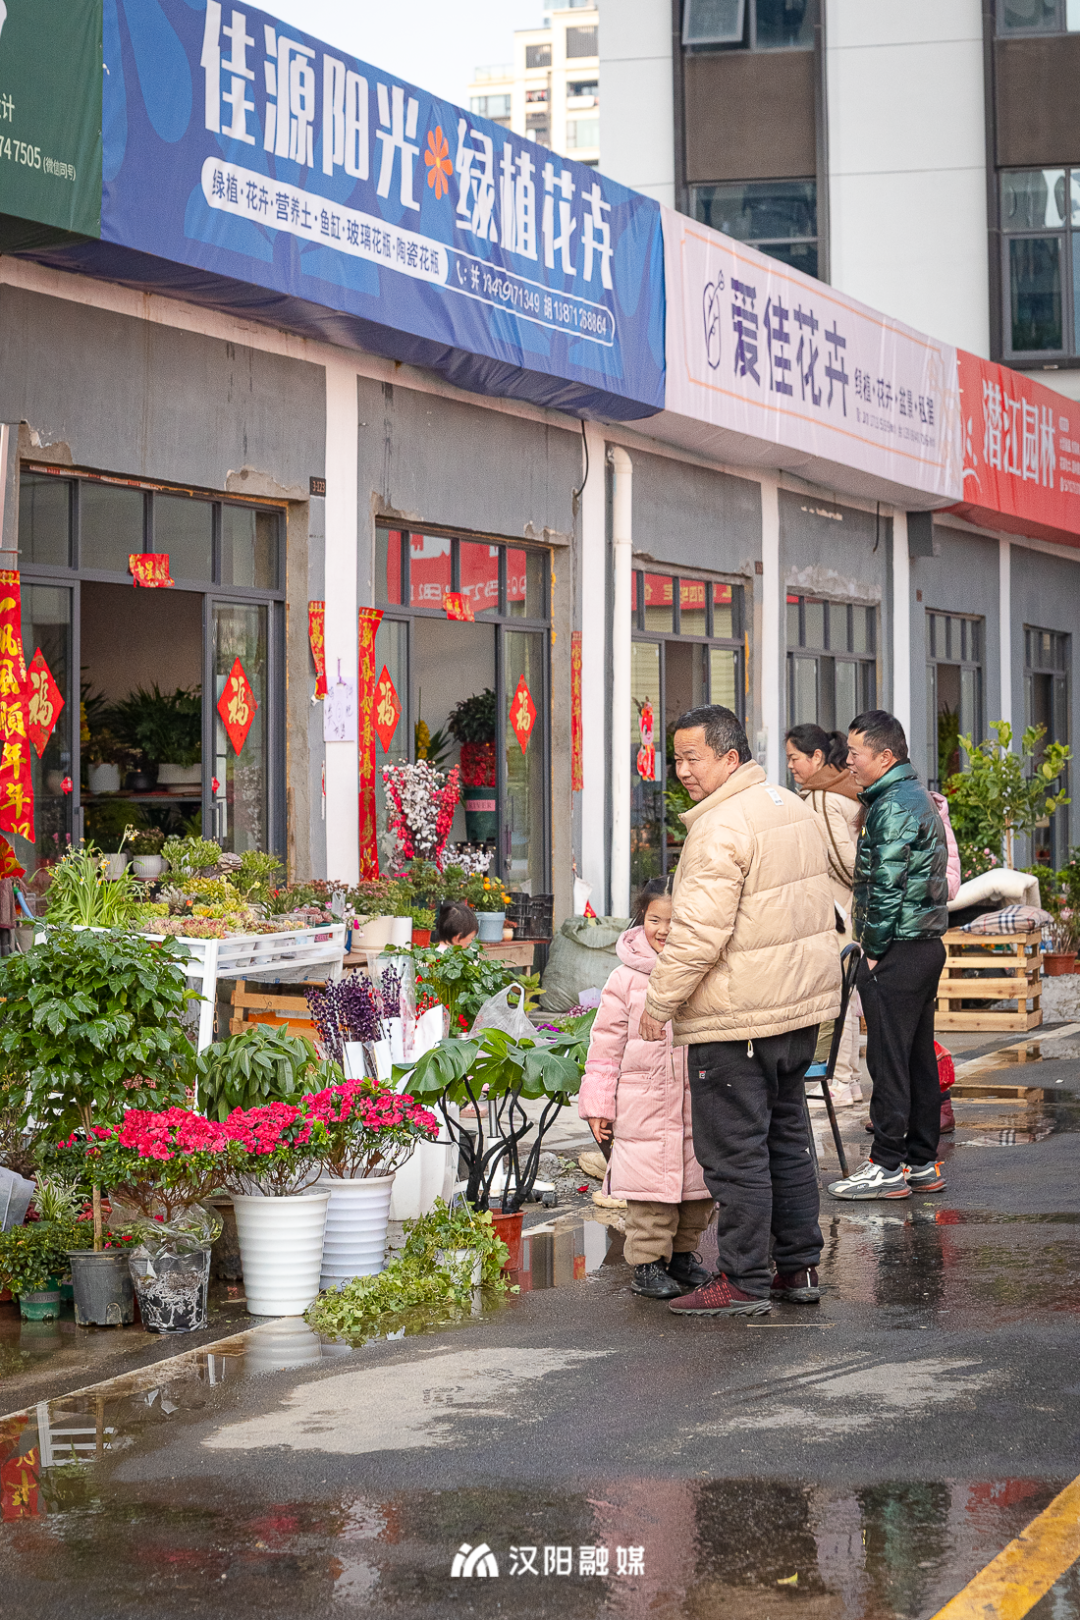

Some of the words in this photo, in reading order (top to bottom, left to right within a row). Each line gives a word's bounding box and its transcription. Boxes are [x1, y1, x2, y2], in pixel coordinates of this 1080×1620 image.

[0, 93, 15, 123] 计
[200, 0, 420, 212] 佳源阳光
[456, 118, 614, 290] 绿植花卉
[731, 277, 849, 417] 爱佳花卉
[982, 377, 1056, 489] 潜江园林
[28, 670, 54, 728] 福
[228, 676, 249, 726] 福
[377, 681, 396, 727] 福
[516, 690, 531, 731] 福
